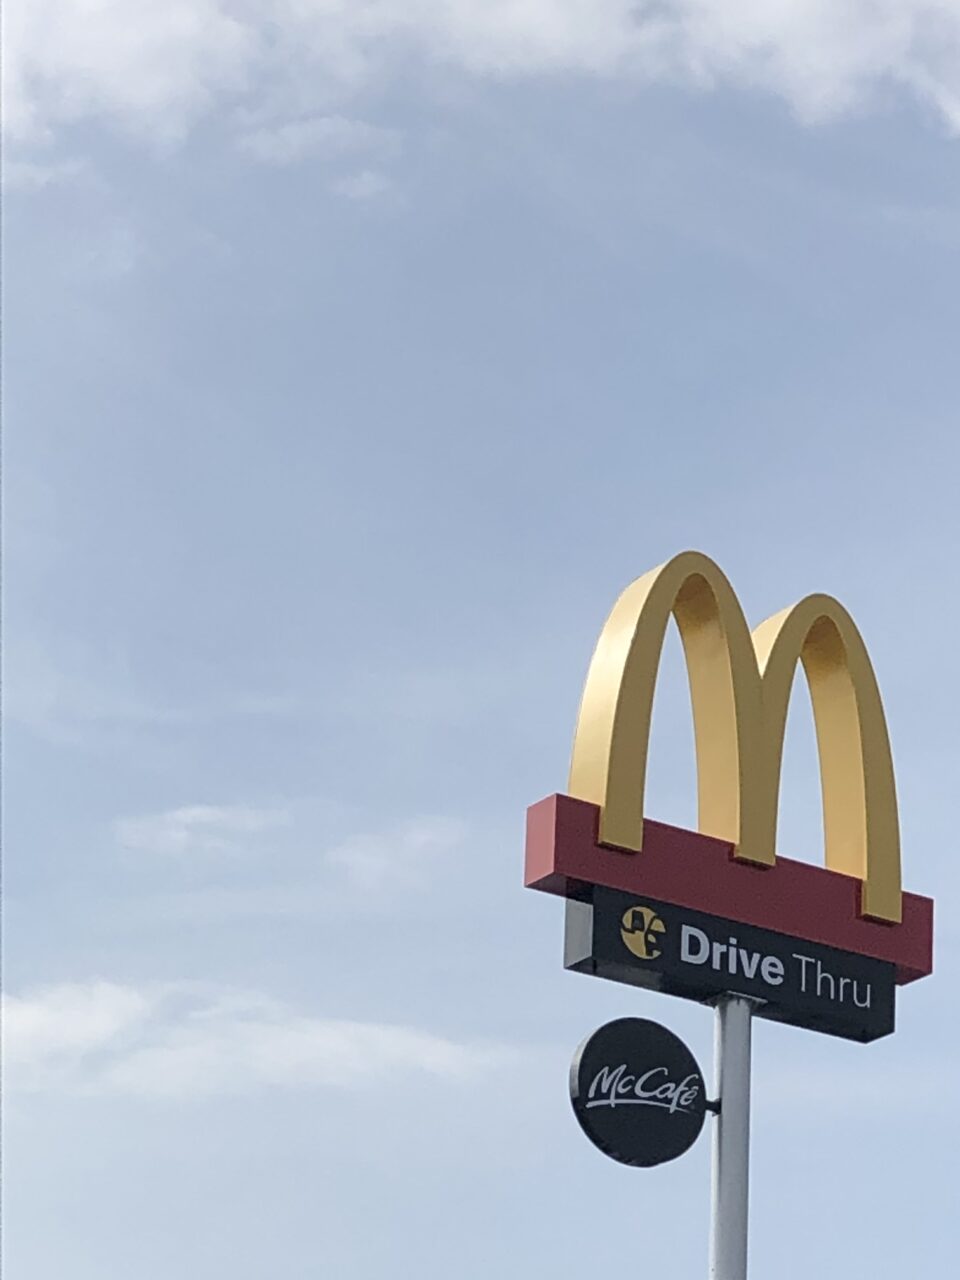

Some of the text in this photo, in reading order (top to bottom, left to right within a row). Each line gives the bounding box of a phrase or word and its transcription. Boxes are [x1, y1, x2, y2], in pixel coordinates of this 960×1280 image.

[680, 924, 871, 1008] Drive Thru
[587, 1063, 699, 1113] McCafé
